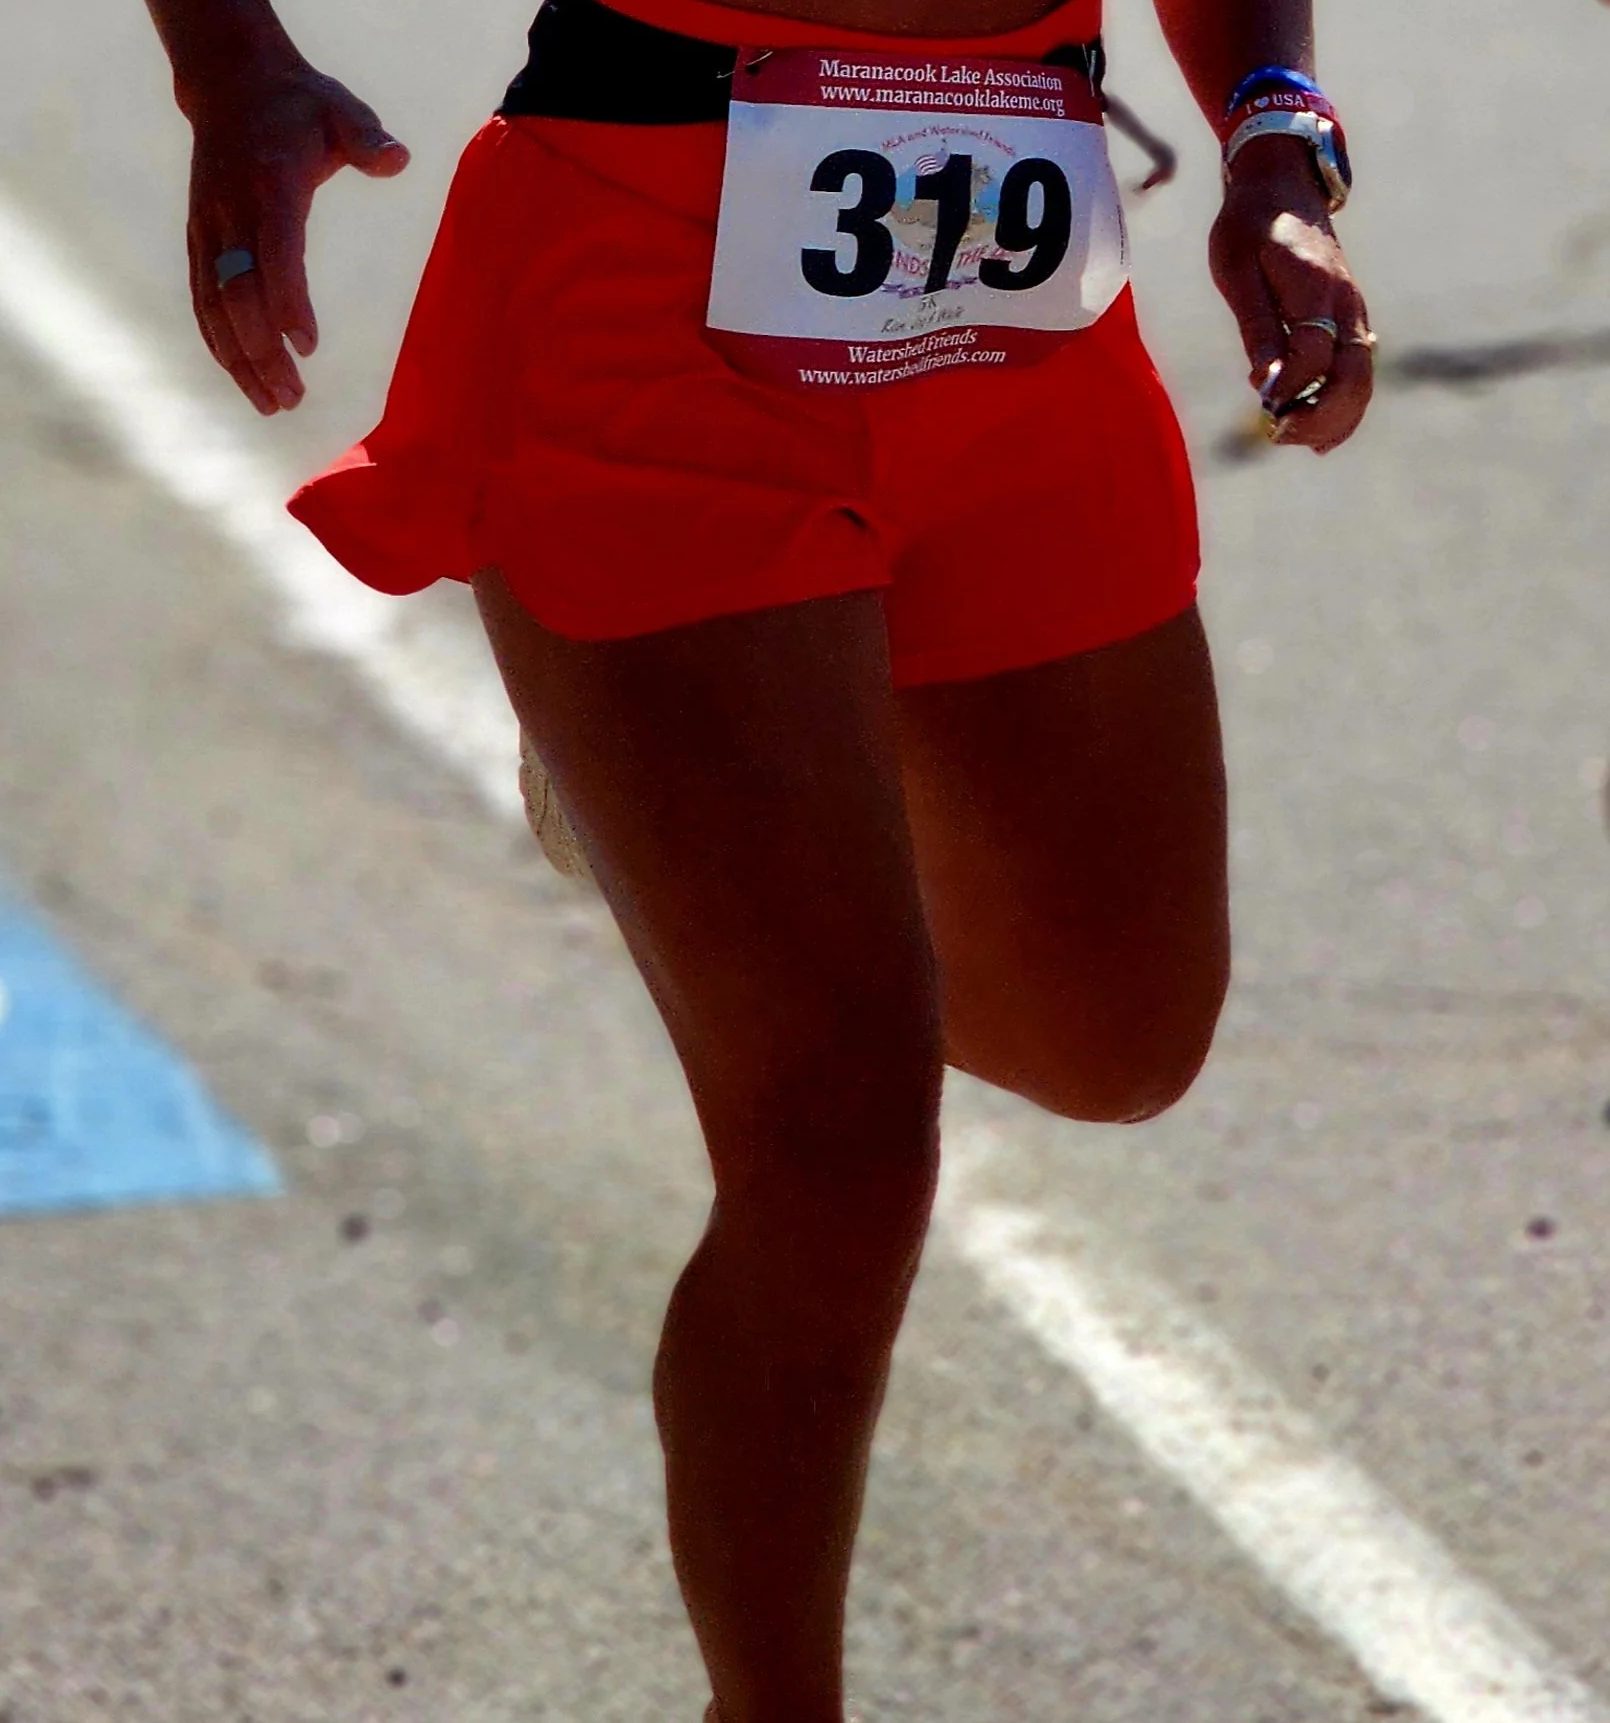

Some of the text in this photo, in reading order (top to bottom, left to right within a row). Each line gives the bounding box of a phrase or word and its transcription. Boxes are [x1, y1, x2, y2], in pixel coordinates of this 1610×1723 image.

[818, 59, 1063, 91] Maranacook Lake Association
[820, 84, 1066, 117] www.maranacooklakeme.org
[1271, 93, 1306, 108] USA
[801, 148, 1072, 297] 319
[797, 347, 1007, 385] www.watershedfriends.com
